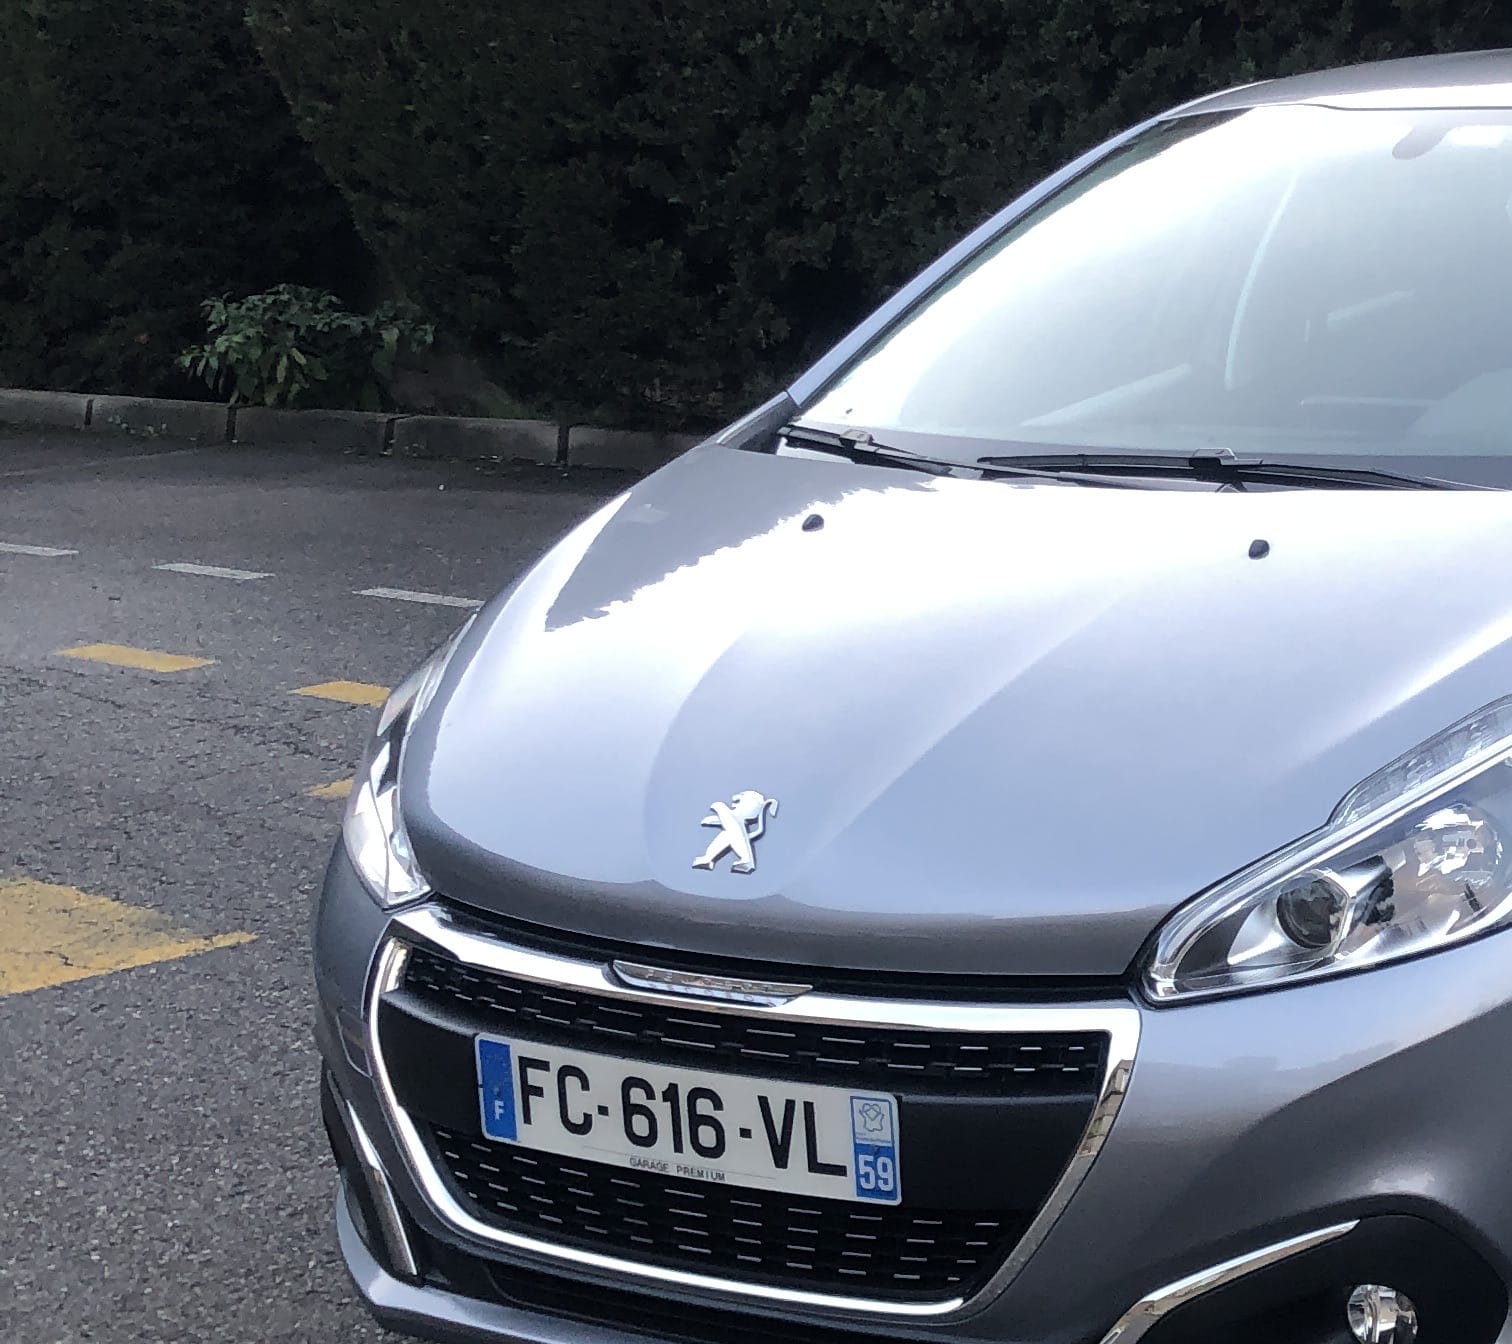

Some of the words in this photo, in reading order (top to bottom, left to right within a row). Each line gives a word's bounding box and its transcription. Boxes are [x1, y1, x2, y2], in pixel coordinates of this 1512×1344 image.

[494, 1099, 505, 1120] F
[518, 1056, 848, 1177] FC-616-VL
[629, 1157, 669, 1173] GARAGE
[676, 1165, 726, 1182] PREMIUM
[858, 1154, 894, 1191] 59
